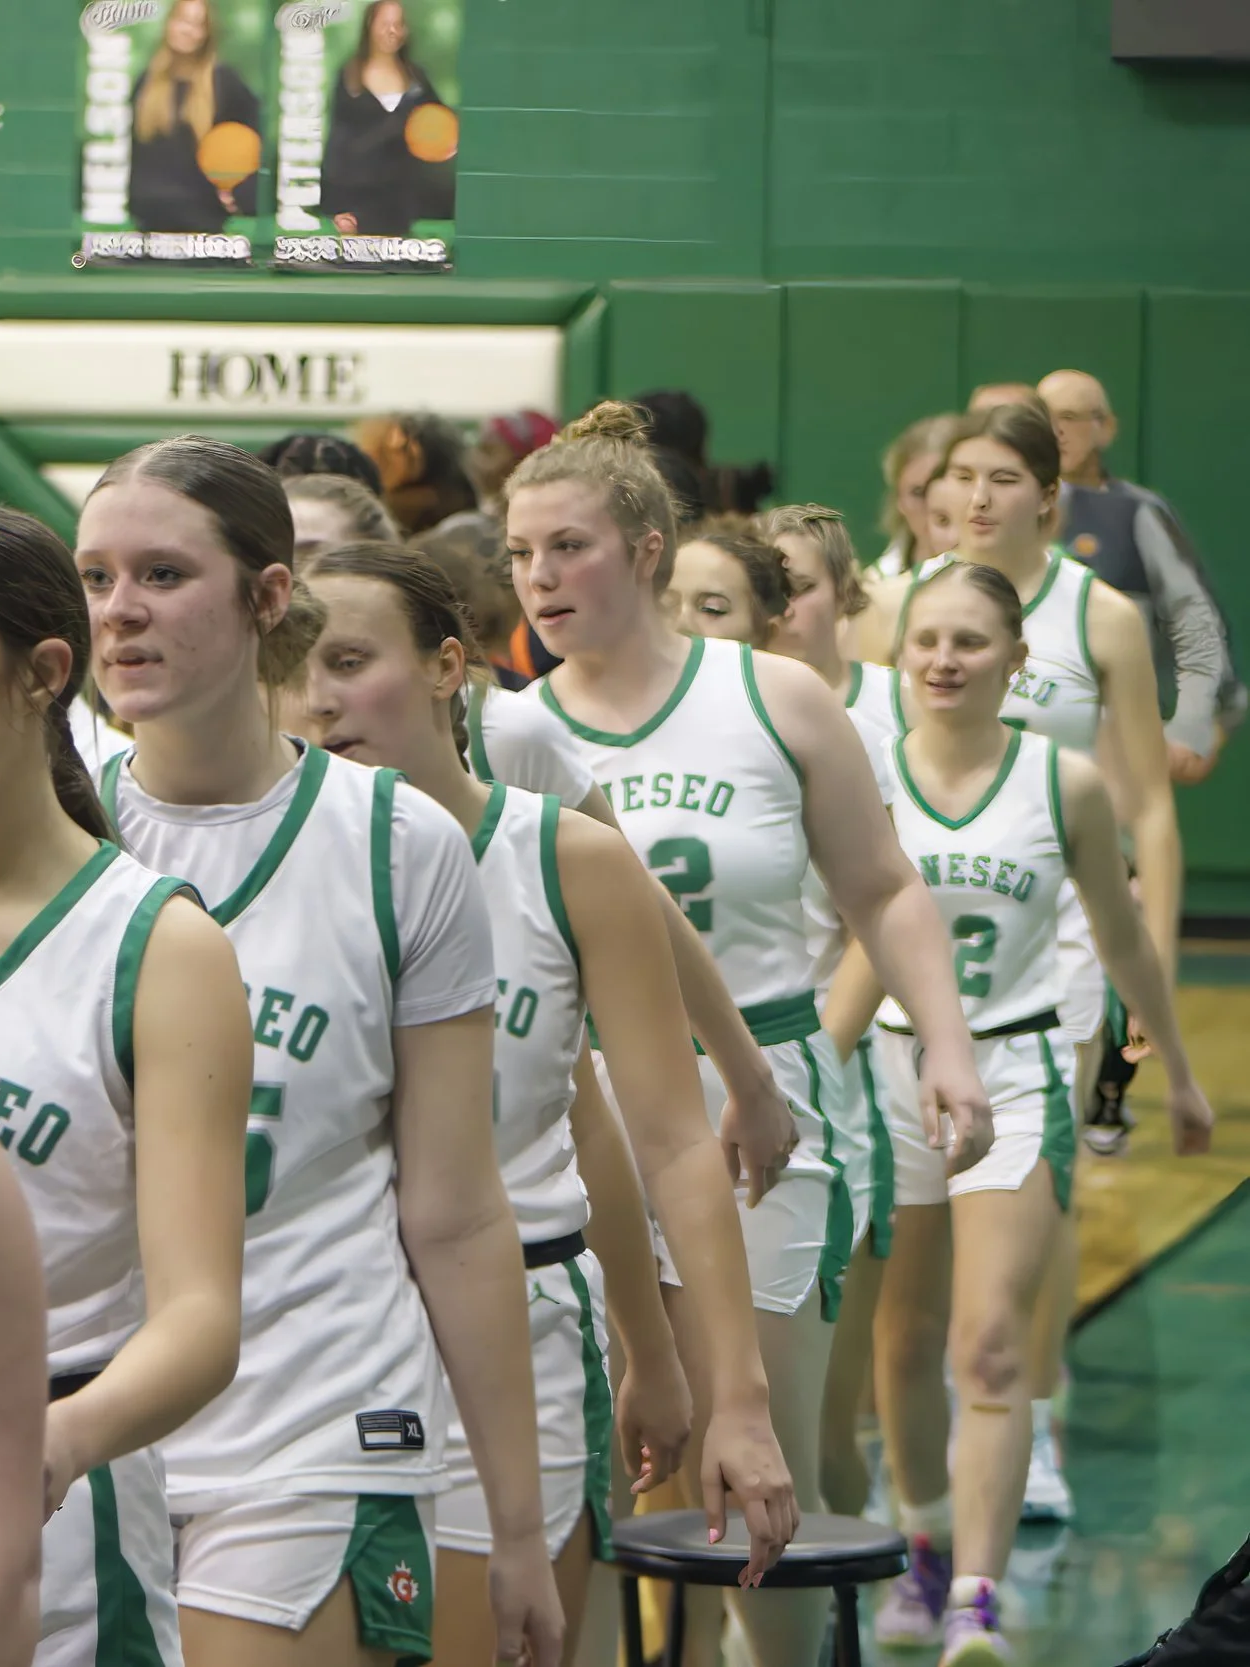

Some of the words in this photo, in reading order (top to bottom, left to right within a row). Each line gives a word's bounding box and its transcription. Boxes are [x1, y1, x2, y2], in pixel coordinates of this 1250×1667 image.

[168, 348, 366, 402] HOME
[243, 981, 330, 1063] EO
[405, 1421, 422, 1438] XL
